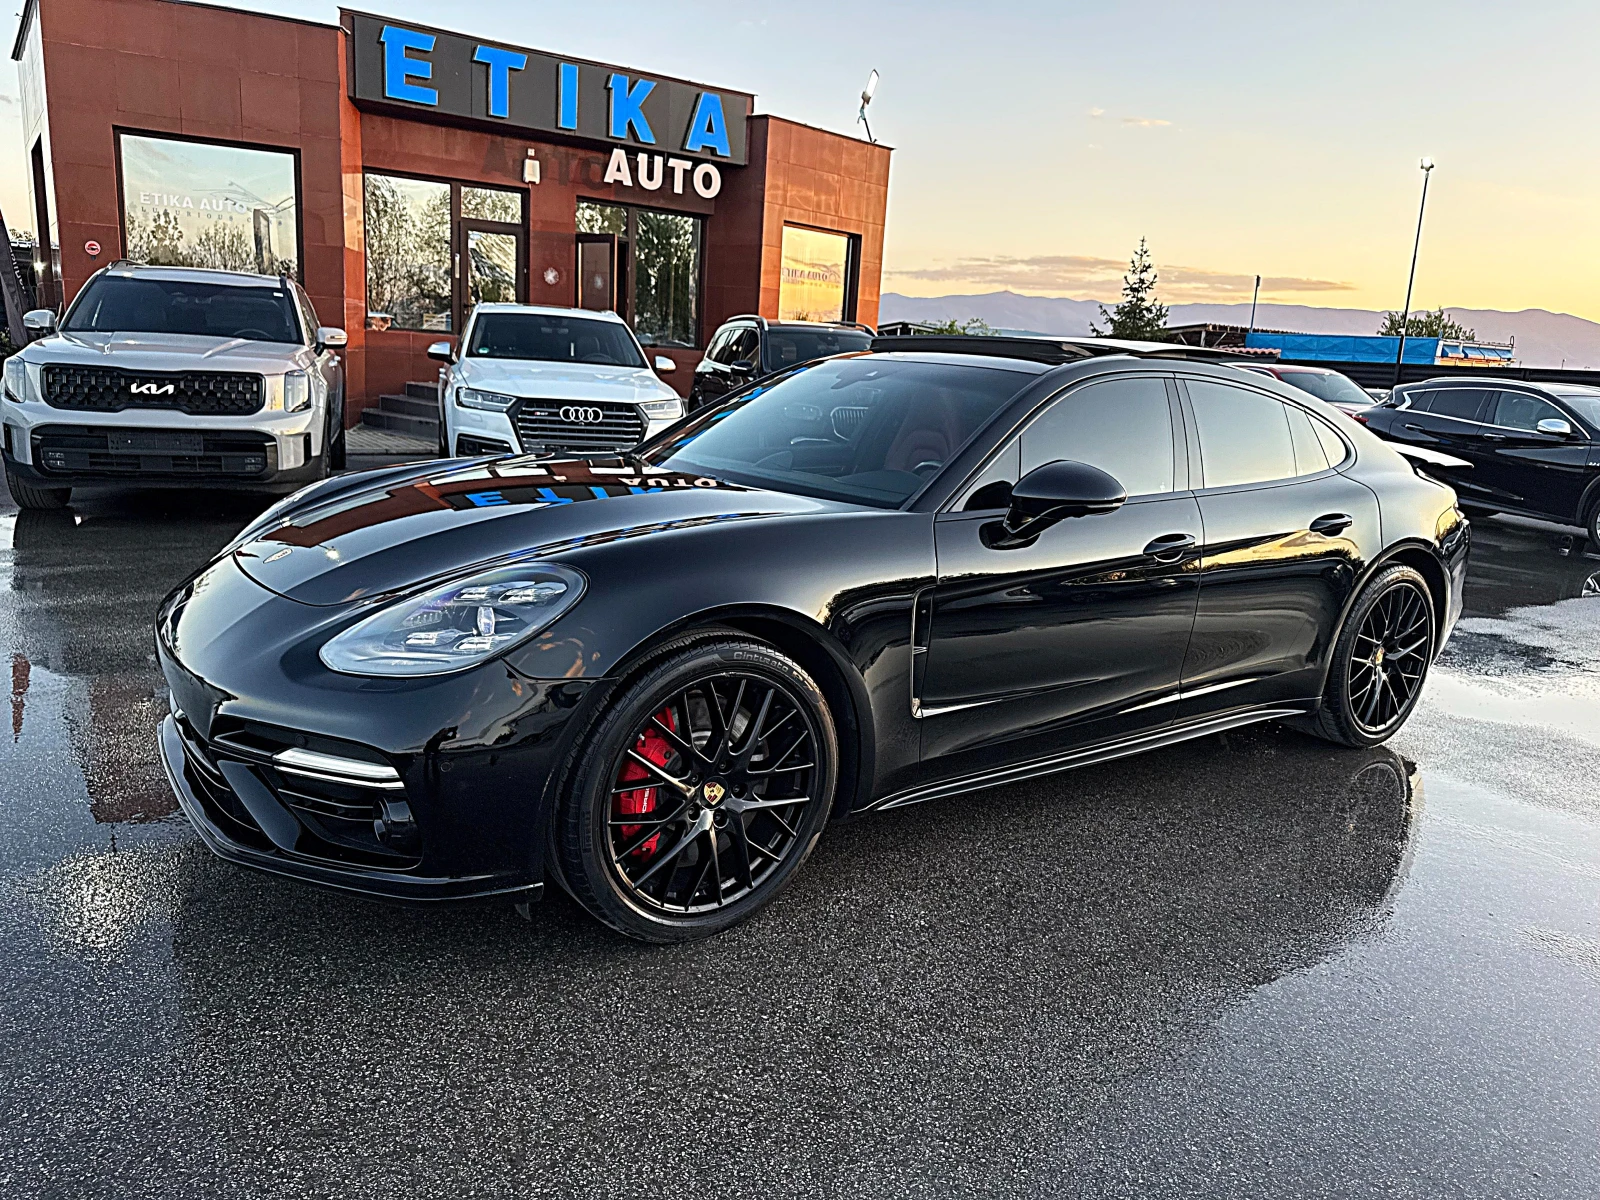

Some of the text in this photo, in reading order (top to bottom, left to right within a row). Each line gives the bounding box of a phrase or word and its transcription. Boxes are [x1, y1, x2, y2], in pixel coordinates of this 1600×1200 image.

[380, 25, 731, 157] ETIKA
[604, 148, 721, 199] AUTO
[140, 192, 247, 214] ETIKA AUTO
[733, 651, 789, 672] Cinturato
